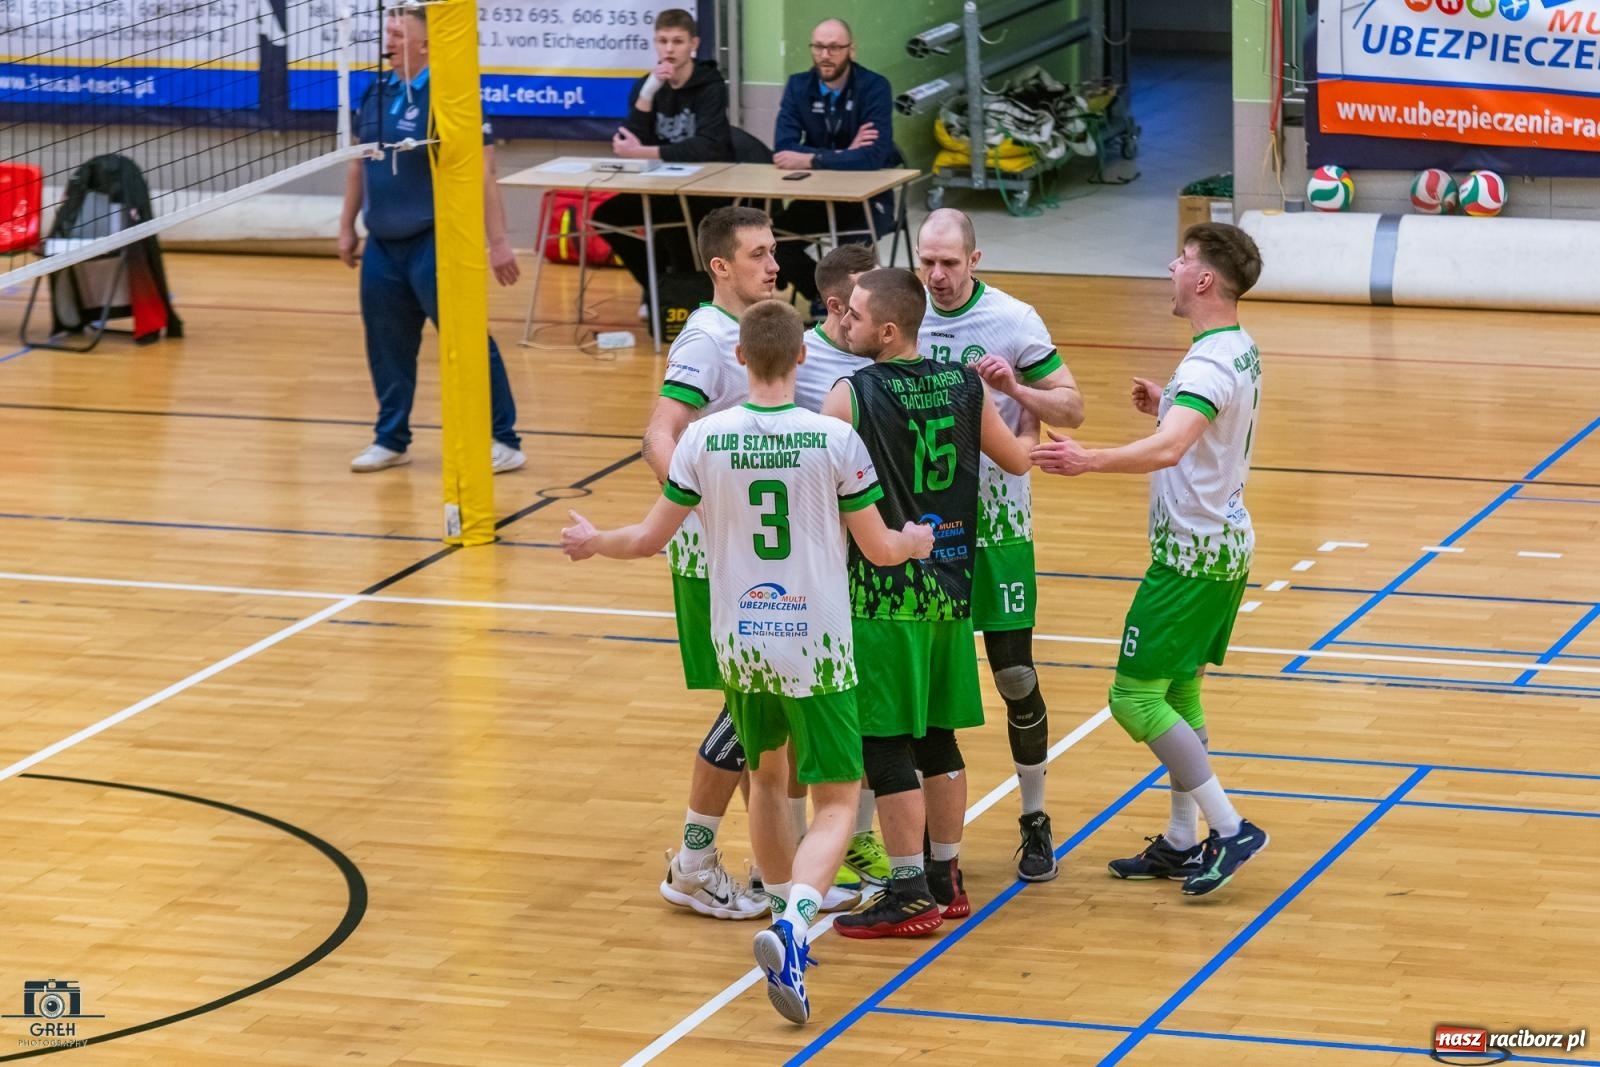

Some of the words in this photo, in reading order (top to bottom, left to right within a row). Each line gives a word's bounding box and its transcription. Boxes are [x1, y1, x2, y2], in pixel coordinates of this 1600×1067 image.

[492, 7, 523, 23] 632
[529, 8, 564, 25] 695,
[572, 9, 603, 24] 606
[607, 10, 638, 26] 363
[506, 35, 538, 48] von
[543, 32, 649, 50] Eichendorffa
[1362, 23, 1600, 70] UBEZPIECZE
[706, 433, 739, 451] KLUB
[743, 432, 828, 451] SIATKARSKI
[731, 450, 801, 470] RACIBÓRZ
[908, 416, 957, 494] 15
[748, 479, 792, 561] 3
[938, 520, 963, 531] MULTI
[739, 600, 807, 611] UBEZPIECZENIA
[781, 595, 806, 603] MULTI
[999, 582, 1025, 613] 13
[738, 620, 808, 636] ENTECO
[1123, 625, 1140, 657] 6
